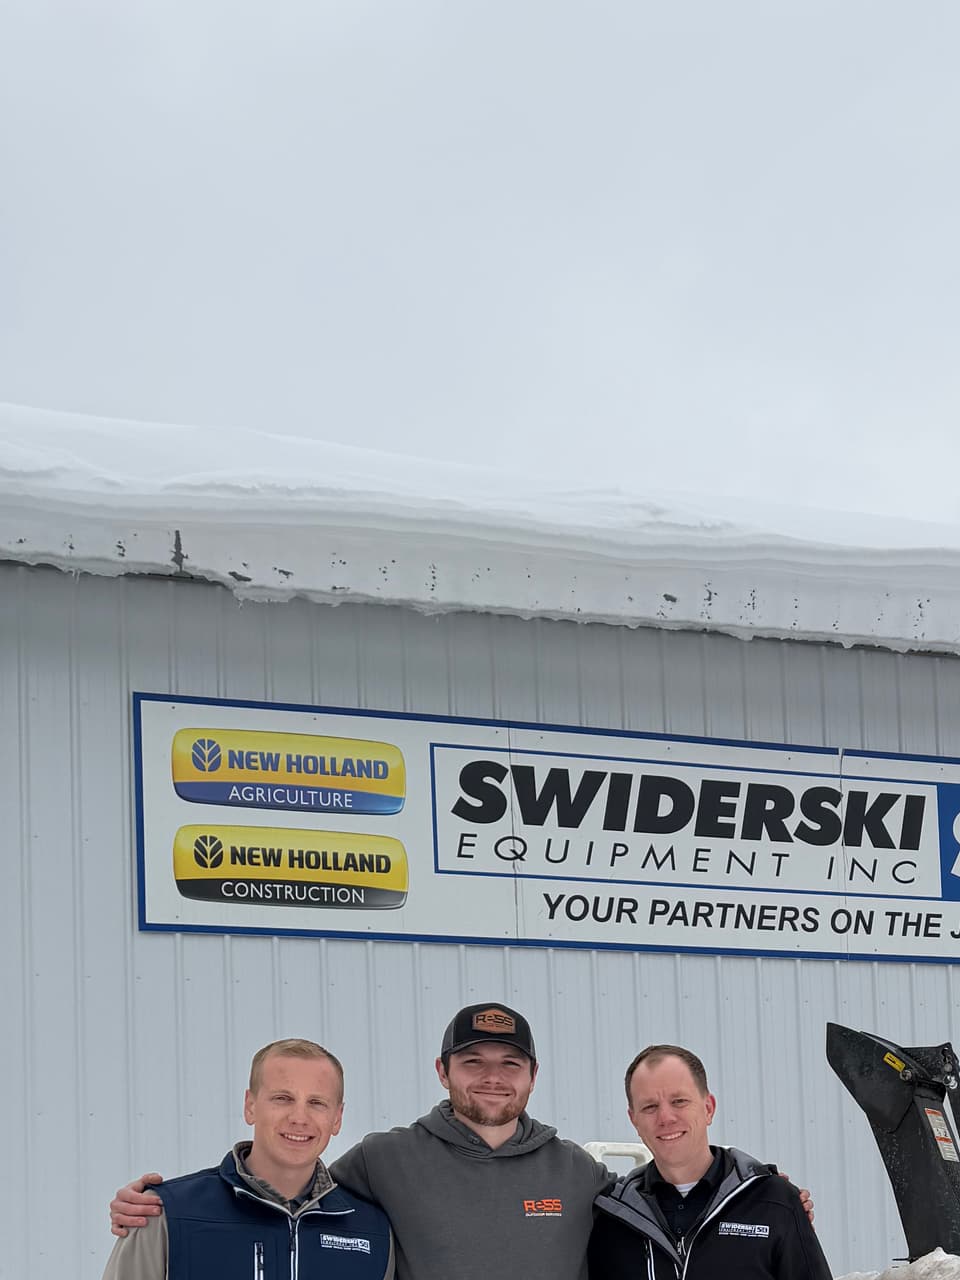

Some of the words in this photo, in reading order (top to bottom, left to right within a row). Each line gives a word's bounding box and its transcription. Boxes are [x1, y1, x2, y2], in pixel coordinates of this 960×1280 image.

[228, 749, 280, 772] NEW
[286, 755, 389, 780] HOLLAND
[228, 785, 353, 808] AGRICULTURE
[451, 760, 926, 851] SWIDERSKI
[230, 845, 282, 868] NEW
[288, 850, 391, 874] HOLLAND
[457, 833, 790, 877] EQUIPMENT
[826, 856, 918, 884] INC
[221, 881, 365, 904] CONSTRUCTION
[543, 893, 639, 925] YOUR
[648, 899, 821, 933] PARTNERS
[830, 908, 875, 936] ON
[884, 911, 943, 938] THE
